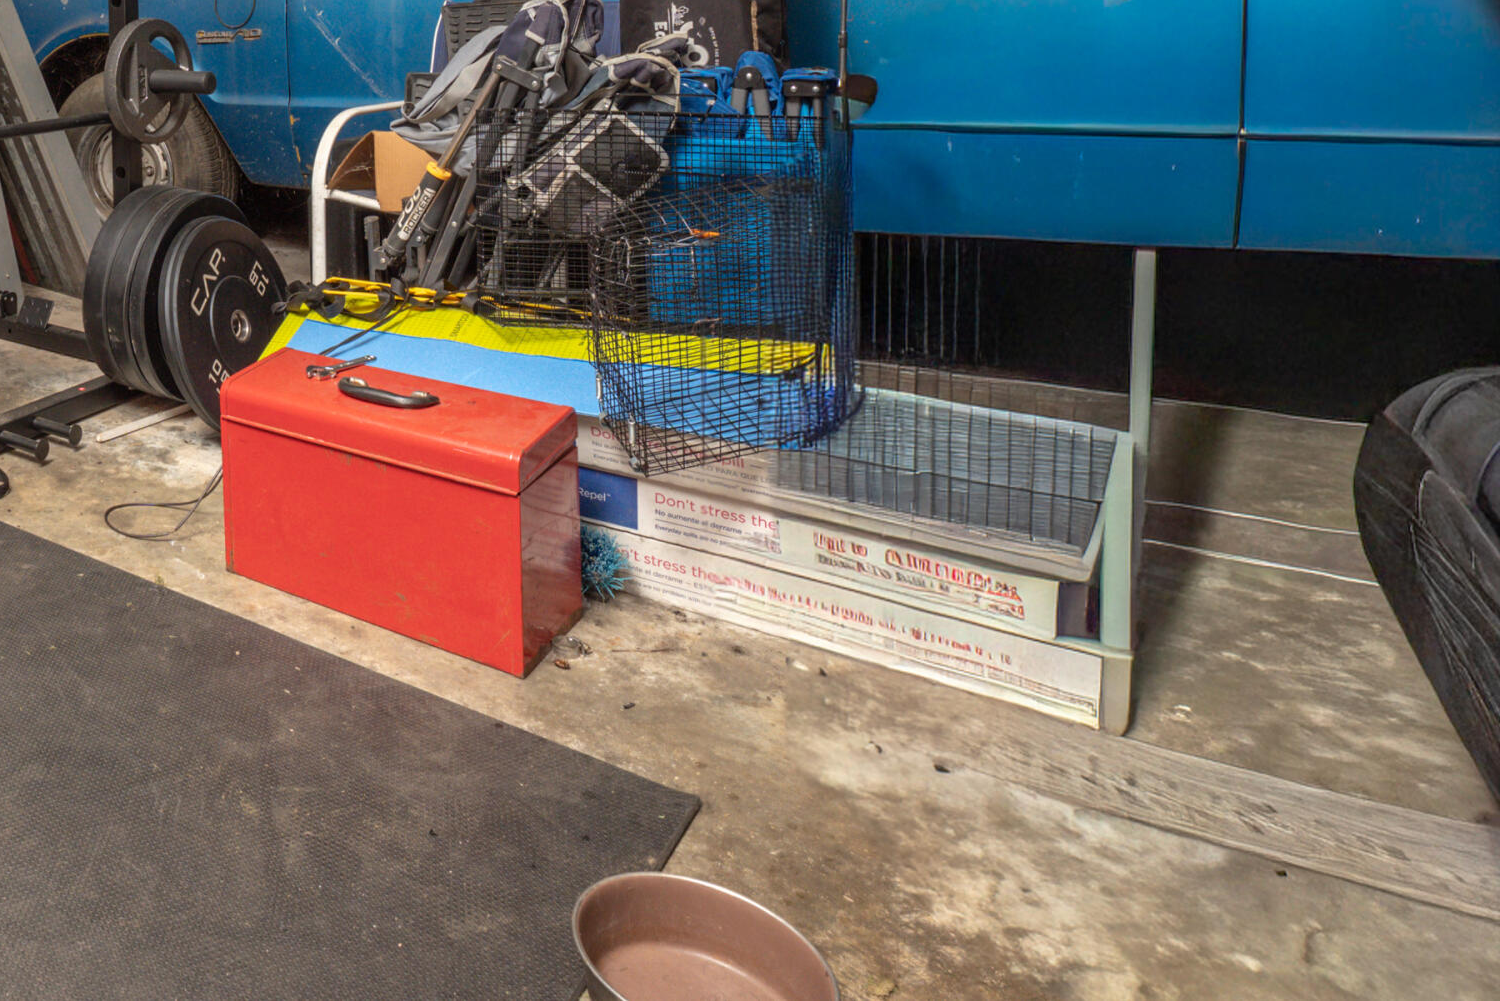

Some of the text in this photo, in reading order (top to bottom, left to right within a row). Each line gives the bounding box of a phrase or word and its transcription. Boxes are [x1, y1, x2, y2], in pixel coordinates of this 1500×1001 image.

[403, 193, 432, 235] ROCKER
[256, 274, 270, 296] 10
[208, 359, 223, 384] 10
[654, 492, 778, 531] Don't stress the
[643, 554, 687, 575] stress
